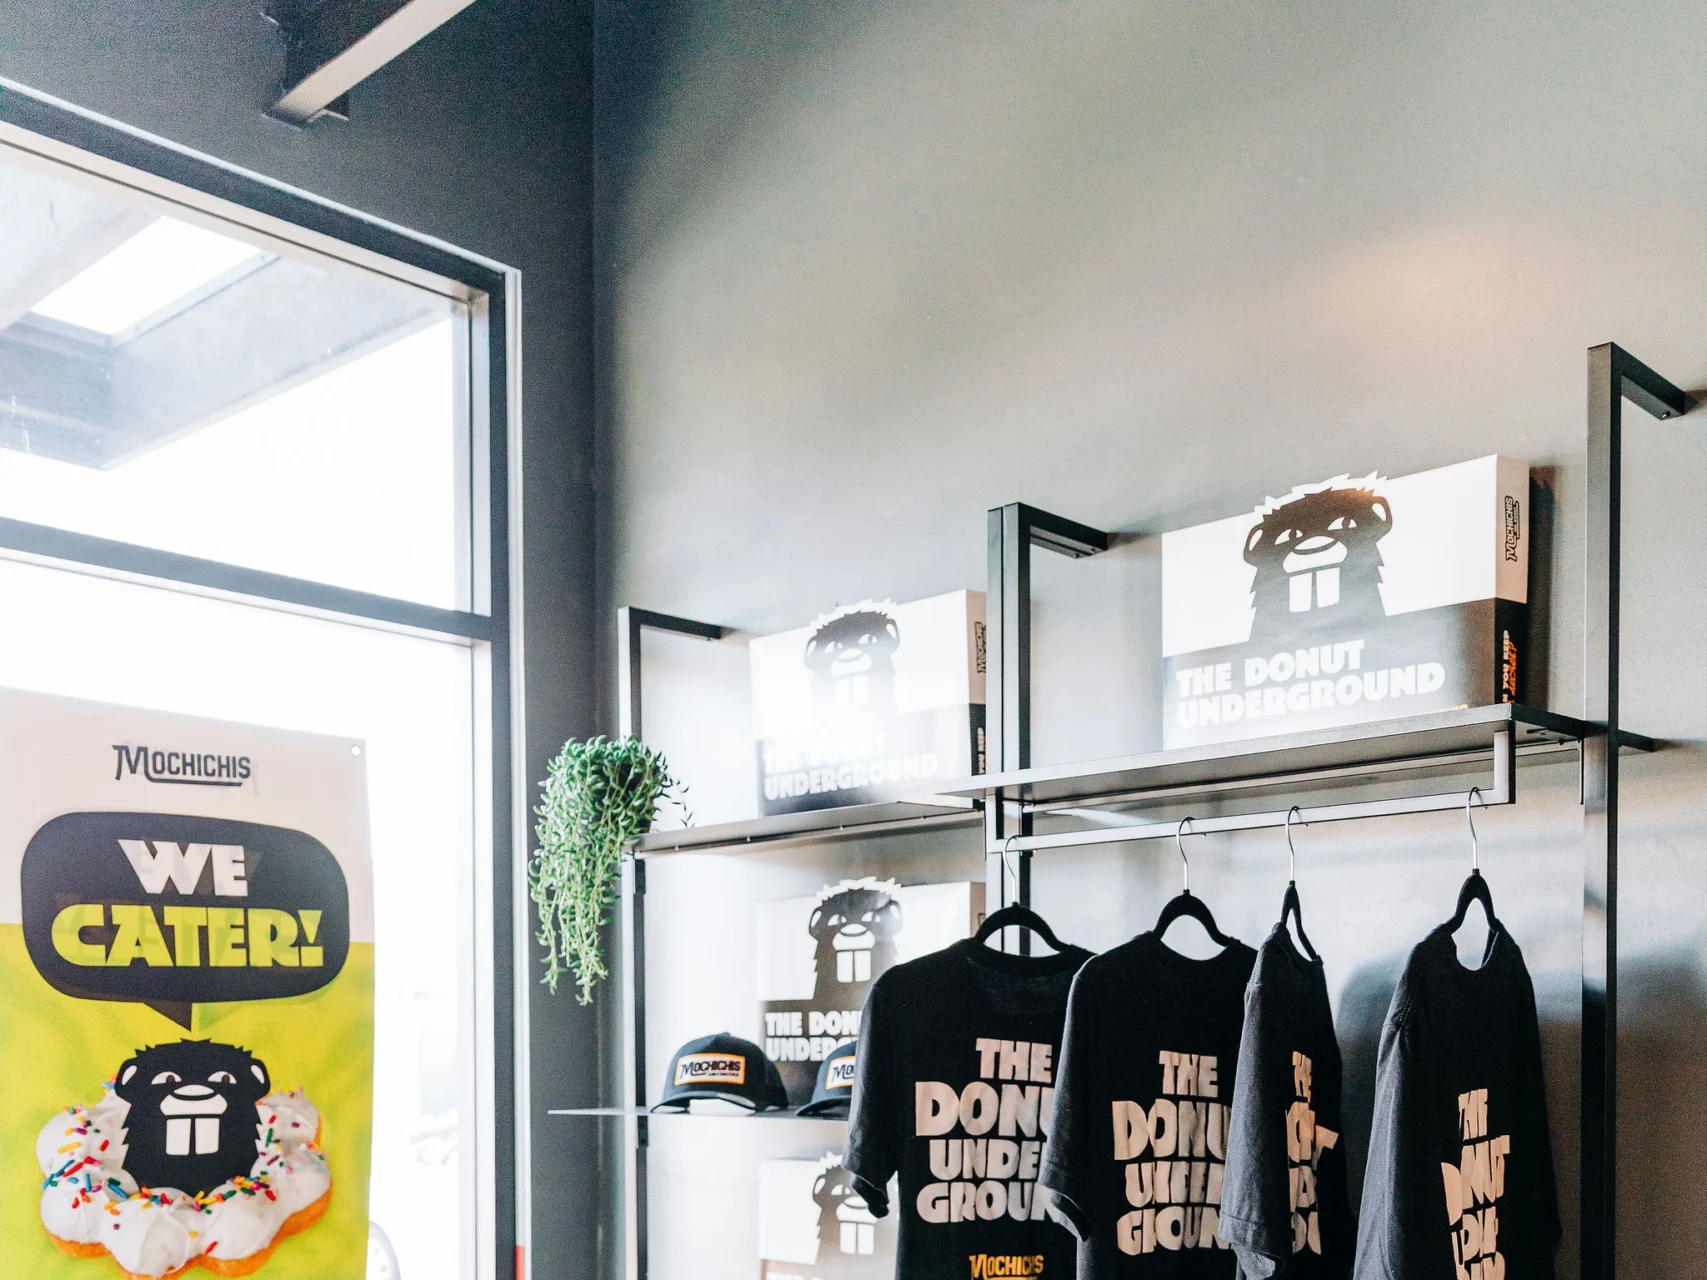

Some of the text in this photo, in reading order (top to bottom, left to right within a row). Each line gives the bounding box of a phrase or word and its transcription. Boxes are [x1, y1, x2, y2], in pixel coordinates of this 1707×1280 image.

[1176, 639, 1365, 697] THE DONUT
[1176, 662, 1446, 729] UNDERGROUND
[112, 744, 251, 787] MOCHICHIS
[764, 752, 939, 800] UNDERGROUND
[117, 839, 248, 896] WE
[51, 903, 324, 967] CATER!
[765, 1010, 862, 1036] THE DON
[976, 1037, 1053, 1083] THE
[1158, 1050, 1218, 1098] THE
[929, 1138, 1048, 1181] UNDE
